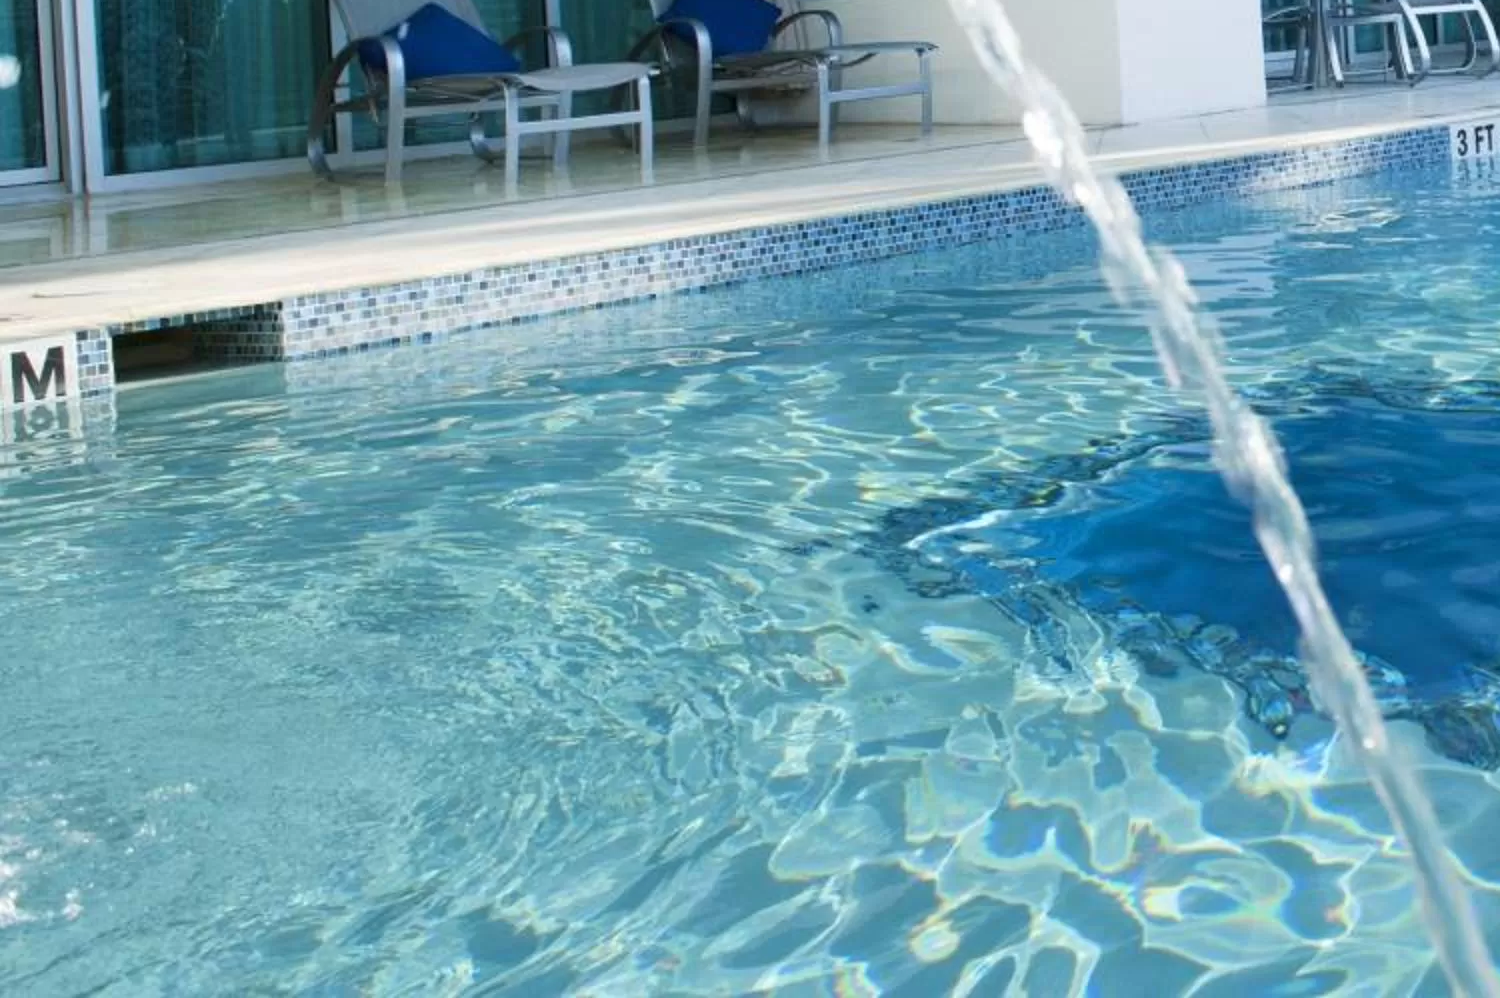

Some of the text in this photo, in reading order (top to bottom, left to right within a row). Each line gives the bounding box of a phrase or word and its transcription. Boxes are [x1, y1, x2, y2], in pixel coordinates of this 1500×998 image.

[1456, 128, 1469, 157] 3
[1474, 123, 1495, 155] FT
[10, 345, 66, 404] M
